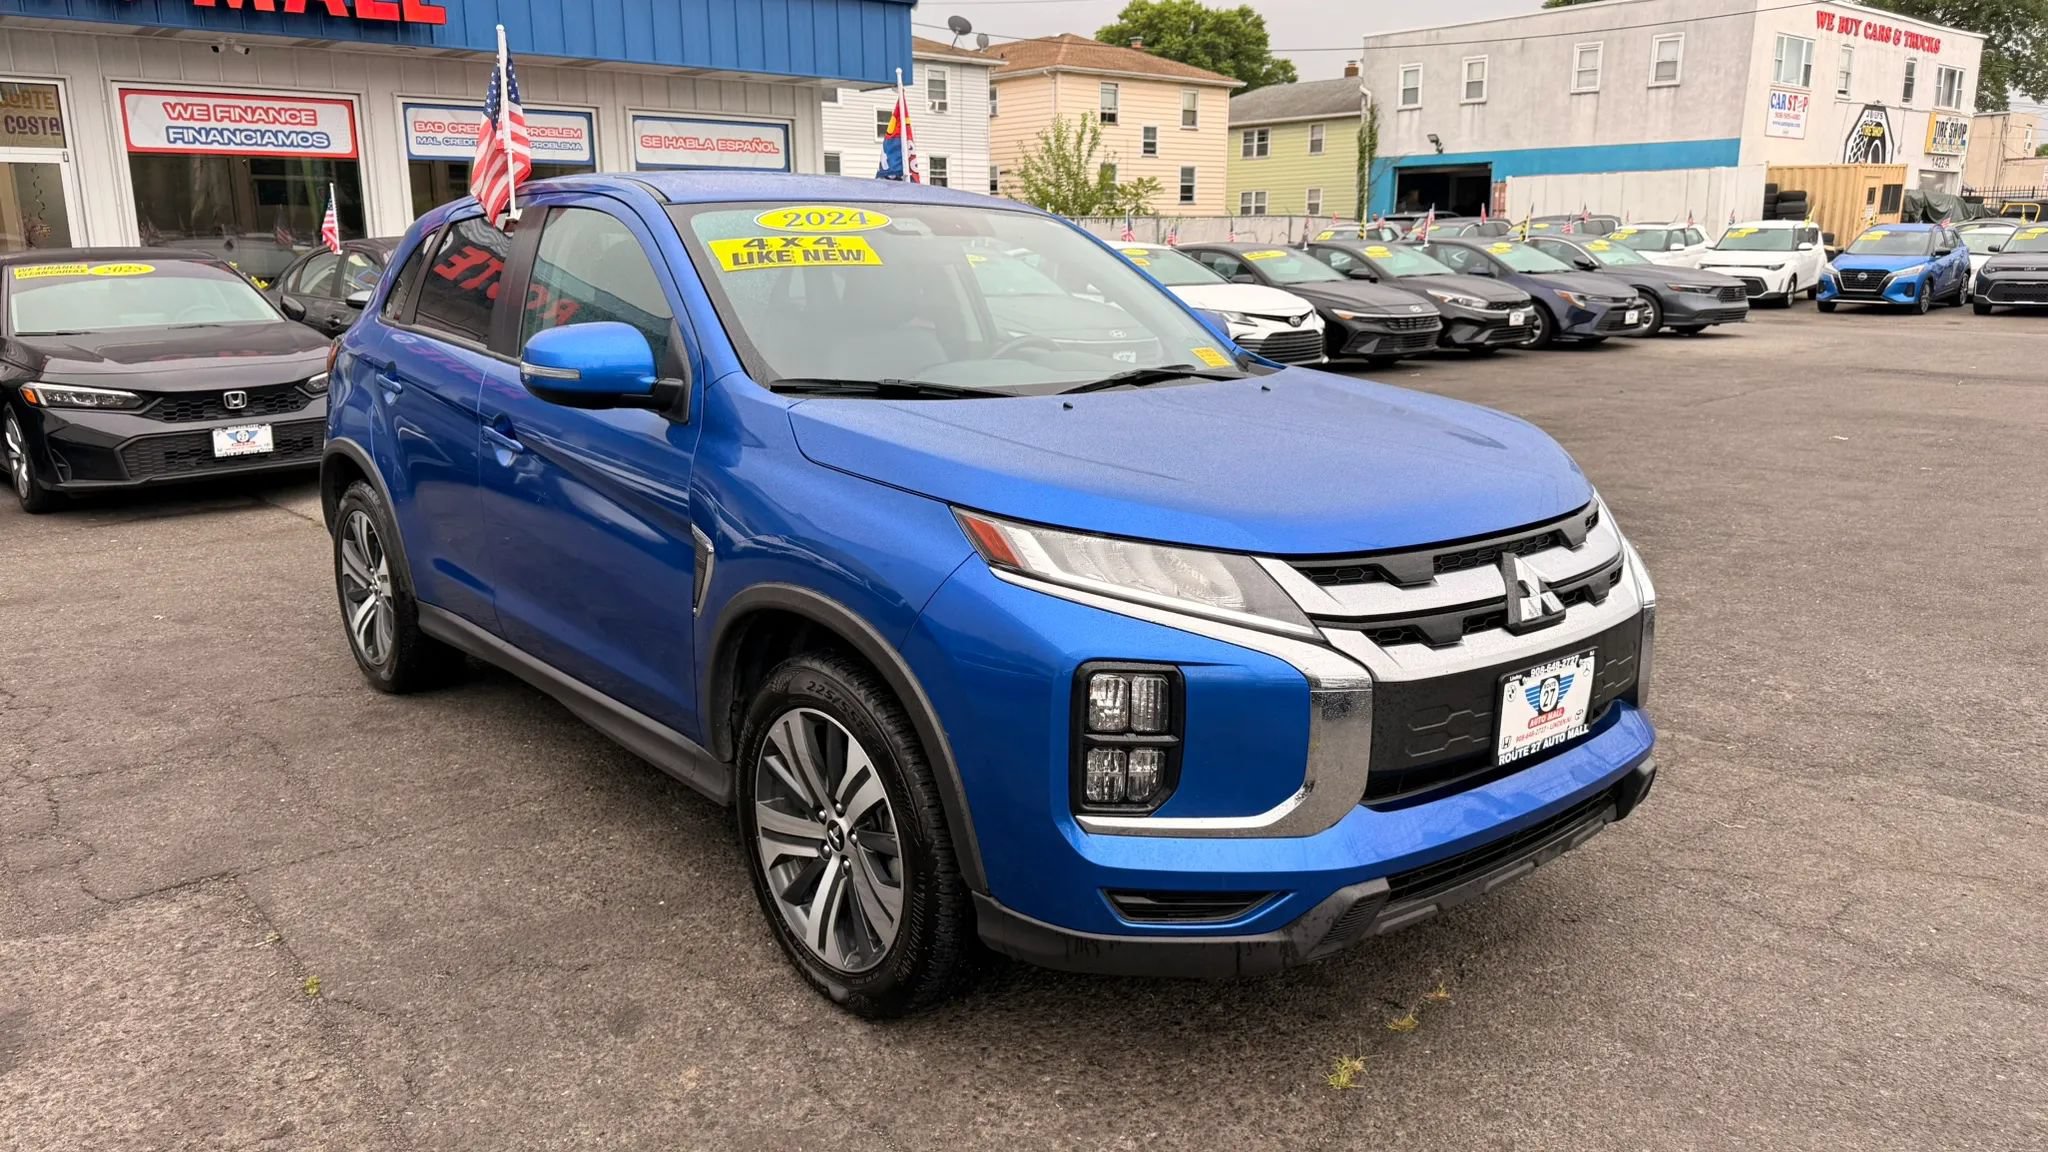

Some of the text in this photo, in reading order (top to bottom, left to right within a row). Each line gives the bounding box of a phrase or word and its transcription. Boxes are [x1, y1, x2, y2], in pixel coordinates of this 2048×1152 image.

[1816, 10, 1941, 54] WE BUY CARS & TRUCKS
[1770, 93, 1786, 110] CAR
[163, 102, 317, 126] WE FINANCE
[4, 115, 61, 136] COSTA
[414, 121, 480, 135] BAD CRED
[1935, 121, 1967, 140] TIRE SHOP
[166, 126, 331, 149] FINANCIAMOS
[416, 136, 478, 146] MAL CREDIT
[529, 141, 583, 151] PROBLEMA
[641, 135, 780, 154] SE HABLA ESPAÑOL
[783, 211, 870, 228] 2024
[732, 249, 866, 266] LIKE NEW
[1542, 688, 1556, 708] 27
[1498, 723, 1590, 766] ROUTE 27 AUTO MALL
